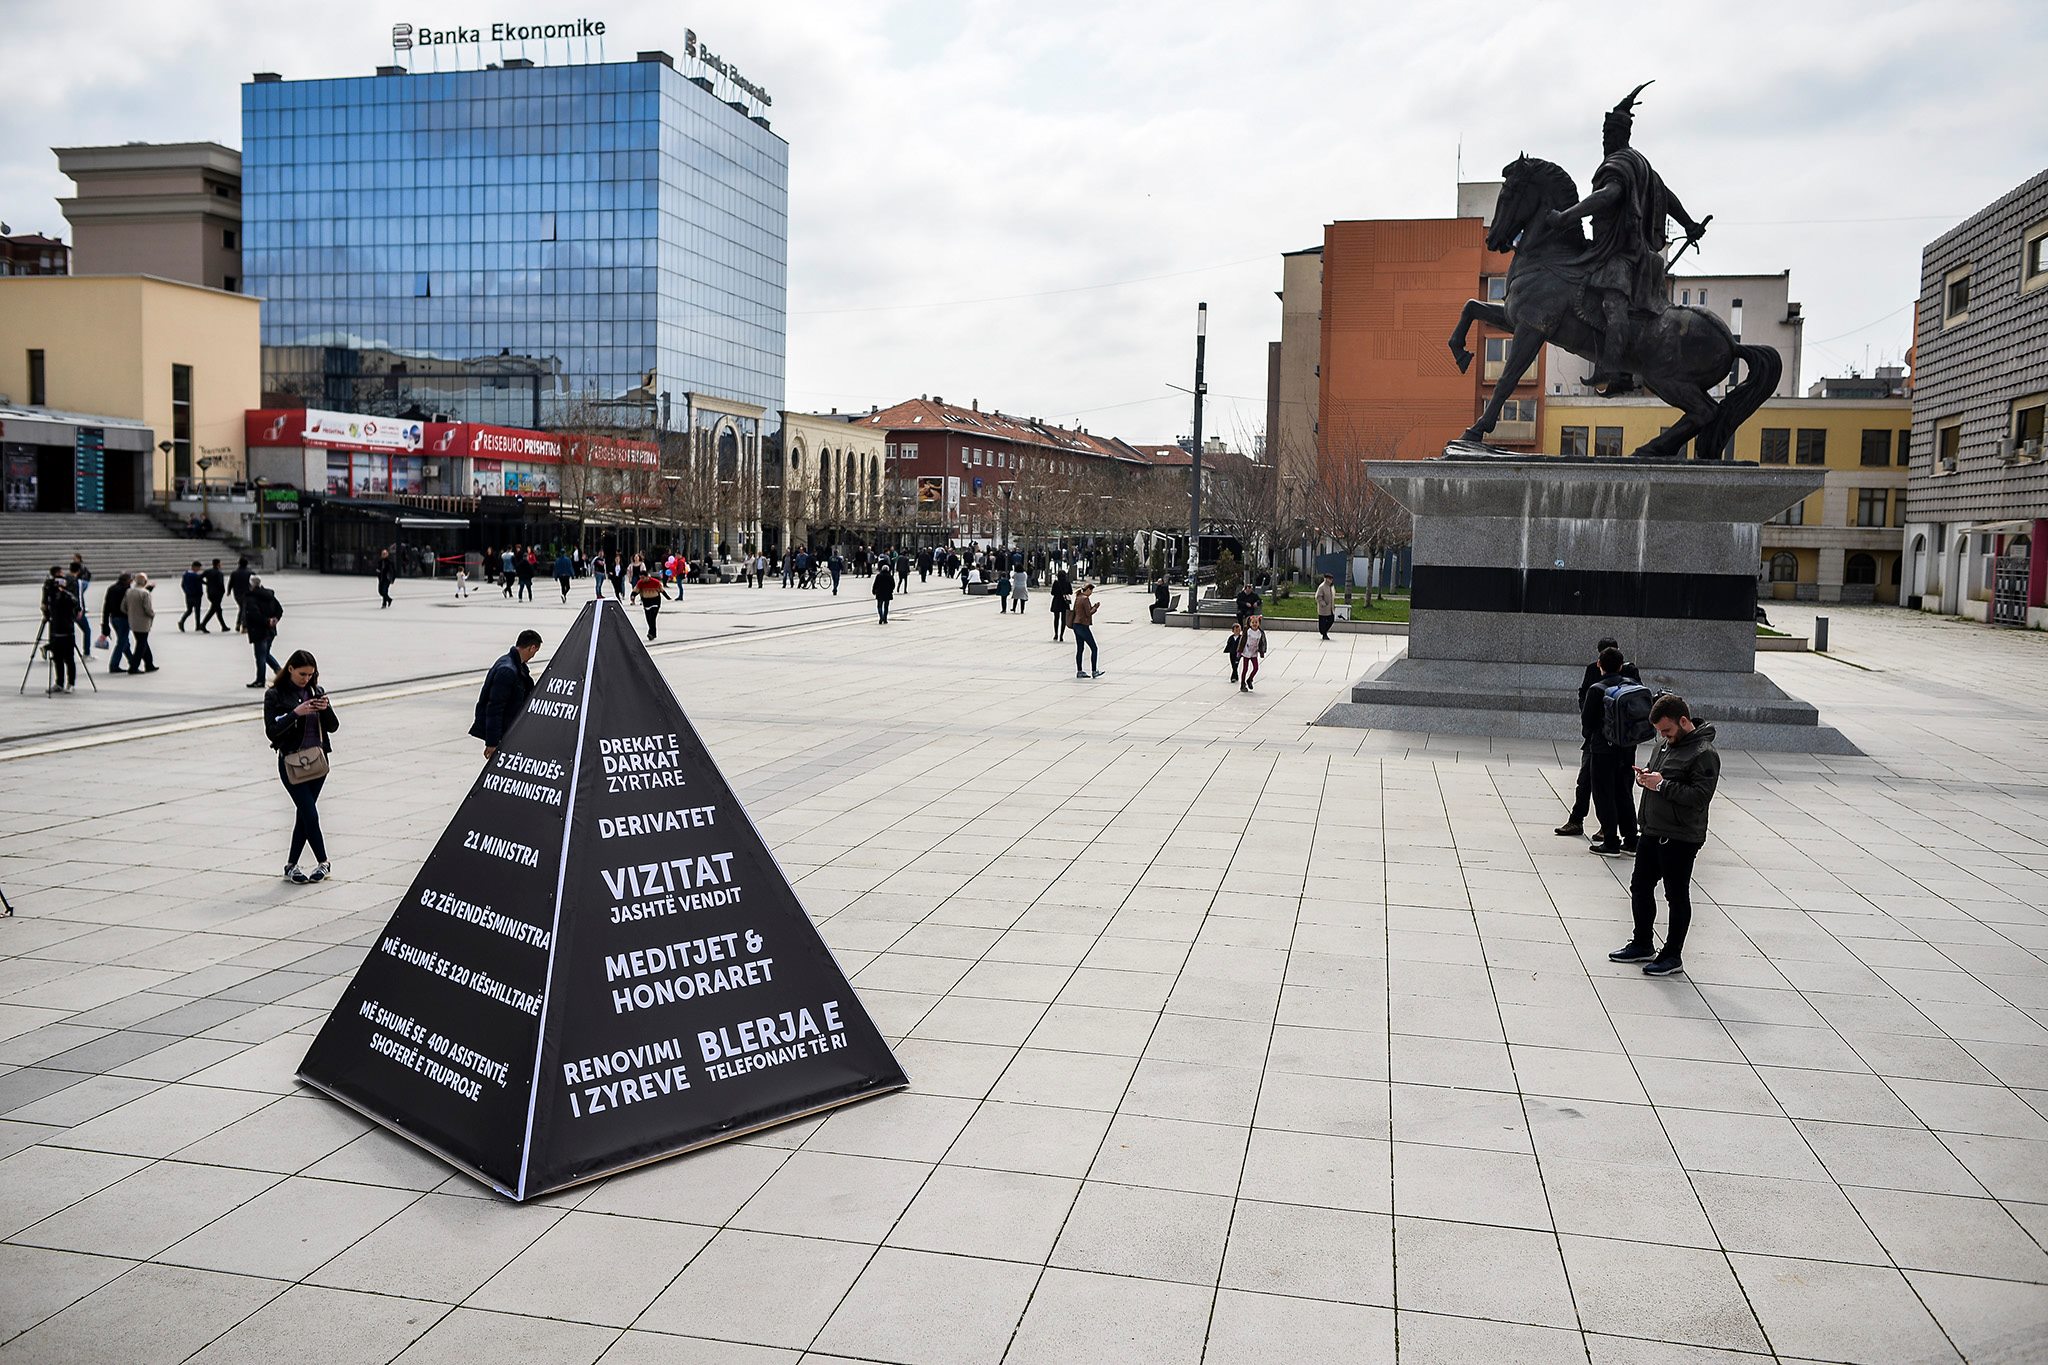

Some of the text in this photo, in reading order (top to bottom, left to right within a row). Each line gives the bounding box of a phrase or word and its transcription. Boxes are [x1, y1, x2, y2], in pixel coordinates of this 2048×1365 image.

[419, 18, 606, 45] Banka Ekonomike
[483, 434, 561, 456] REISEBURO PRISHTINA
[546, 677, 577, 696] KRYE
[528, 698, 578, 720] MINISTRI
[600, 734, 678, 755] DREKAT E
[603, 750, 680, 774] DARKAT
[497, 752, 565, 780] 5 ZËVENDËS-
[607, 770, 686, 793] ZYRTARE
[483, 773, 563, 806] KRYEMINISTRA
[599, 806, 716, 838] DERIVATET
[464, 831, 540, 868] 21 MINISTRA
[601, 851, 734, 900] VIZITAT
[420, 888, 551, 950] 82 ZËVENDËSMINISTRA
[610, 887, 742, 924] JASHTË VENDIT
[605, 929, 764, 982] MEDITJET &
[381, 936, 544, 1017] MË SHUMË SE 120 KËSHILLTARË
[612, 958, 774, 1014] HONORARET
[359, 1000, 509, 1089] MË SHUMË SE 400 ASISTENTË,
[697, 1001, 844, 1063] BLERJA E
[370, 1032, 483, 1102] SHOFERË E TRUPROJE
[563, 1038, 683, 1085] RENOVIMI
[705, 1033, 848, 1081] TELEFONAVE TË RI
[570, 1066, 691, 1118] I ZYREVE
